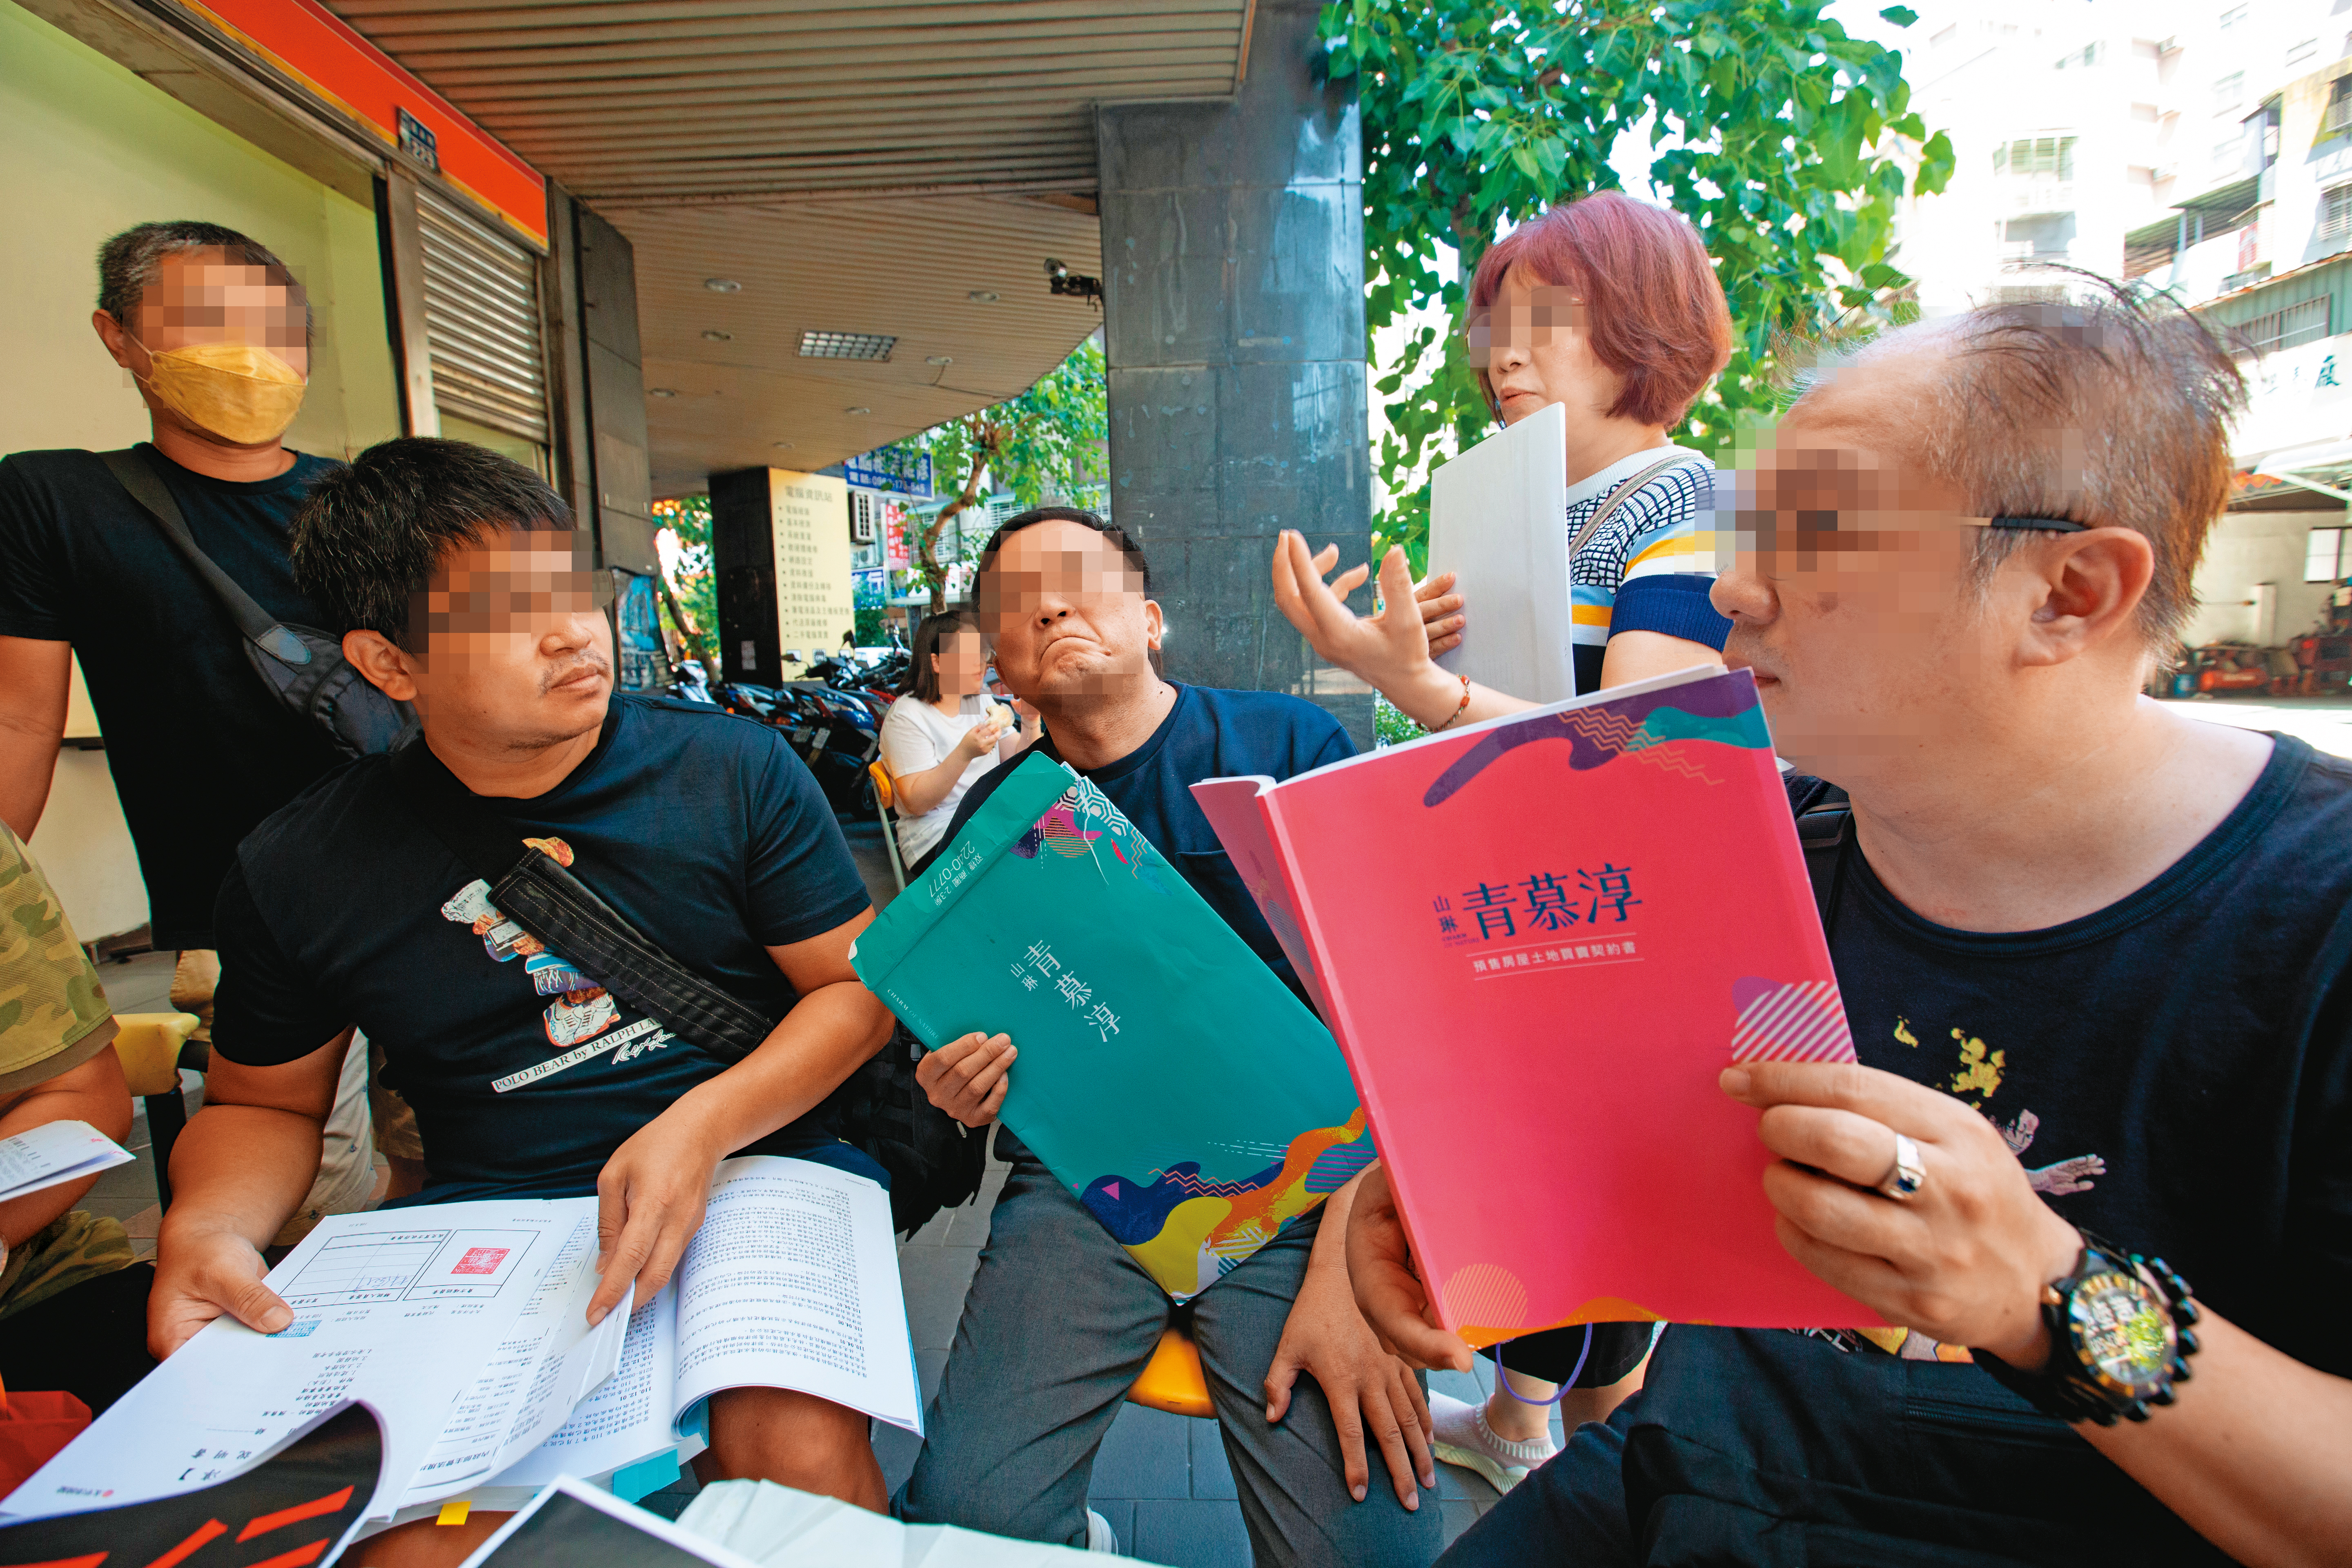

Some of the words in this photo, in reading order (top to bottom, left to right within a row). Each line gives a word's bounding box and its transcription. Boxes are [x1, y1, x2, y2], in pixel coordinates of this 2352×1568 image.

[929, 840, 975, 898] 2240-0777
[1433, 895, 1458, 933] 山琳
[1462, 863, 1643, 940] 青慕淳
[1473, 941, 1636, 973] 預售房屋土地買賣契約書
[1010, 963, 1038, 991] 山琳
[1023, 940, 1121, 1042] 青慕淳
[887, 989, 909, 1010] CHARM
[919, 1018, 939, 1040] NATURE
[494, 1071, 529, 1090] POLO
[533, 1056, 572, 1076] BEAR
[574, 1049, 587, 1059] by
[591, 1027, 636, 1052] RALPH
[835, 1274, 858, 1285] 110.04.14
[837, 1302, 861, 1313] 110.04.07
[840, 1339, 864, 1351] 110.04.01
